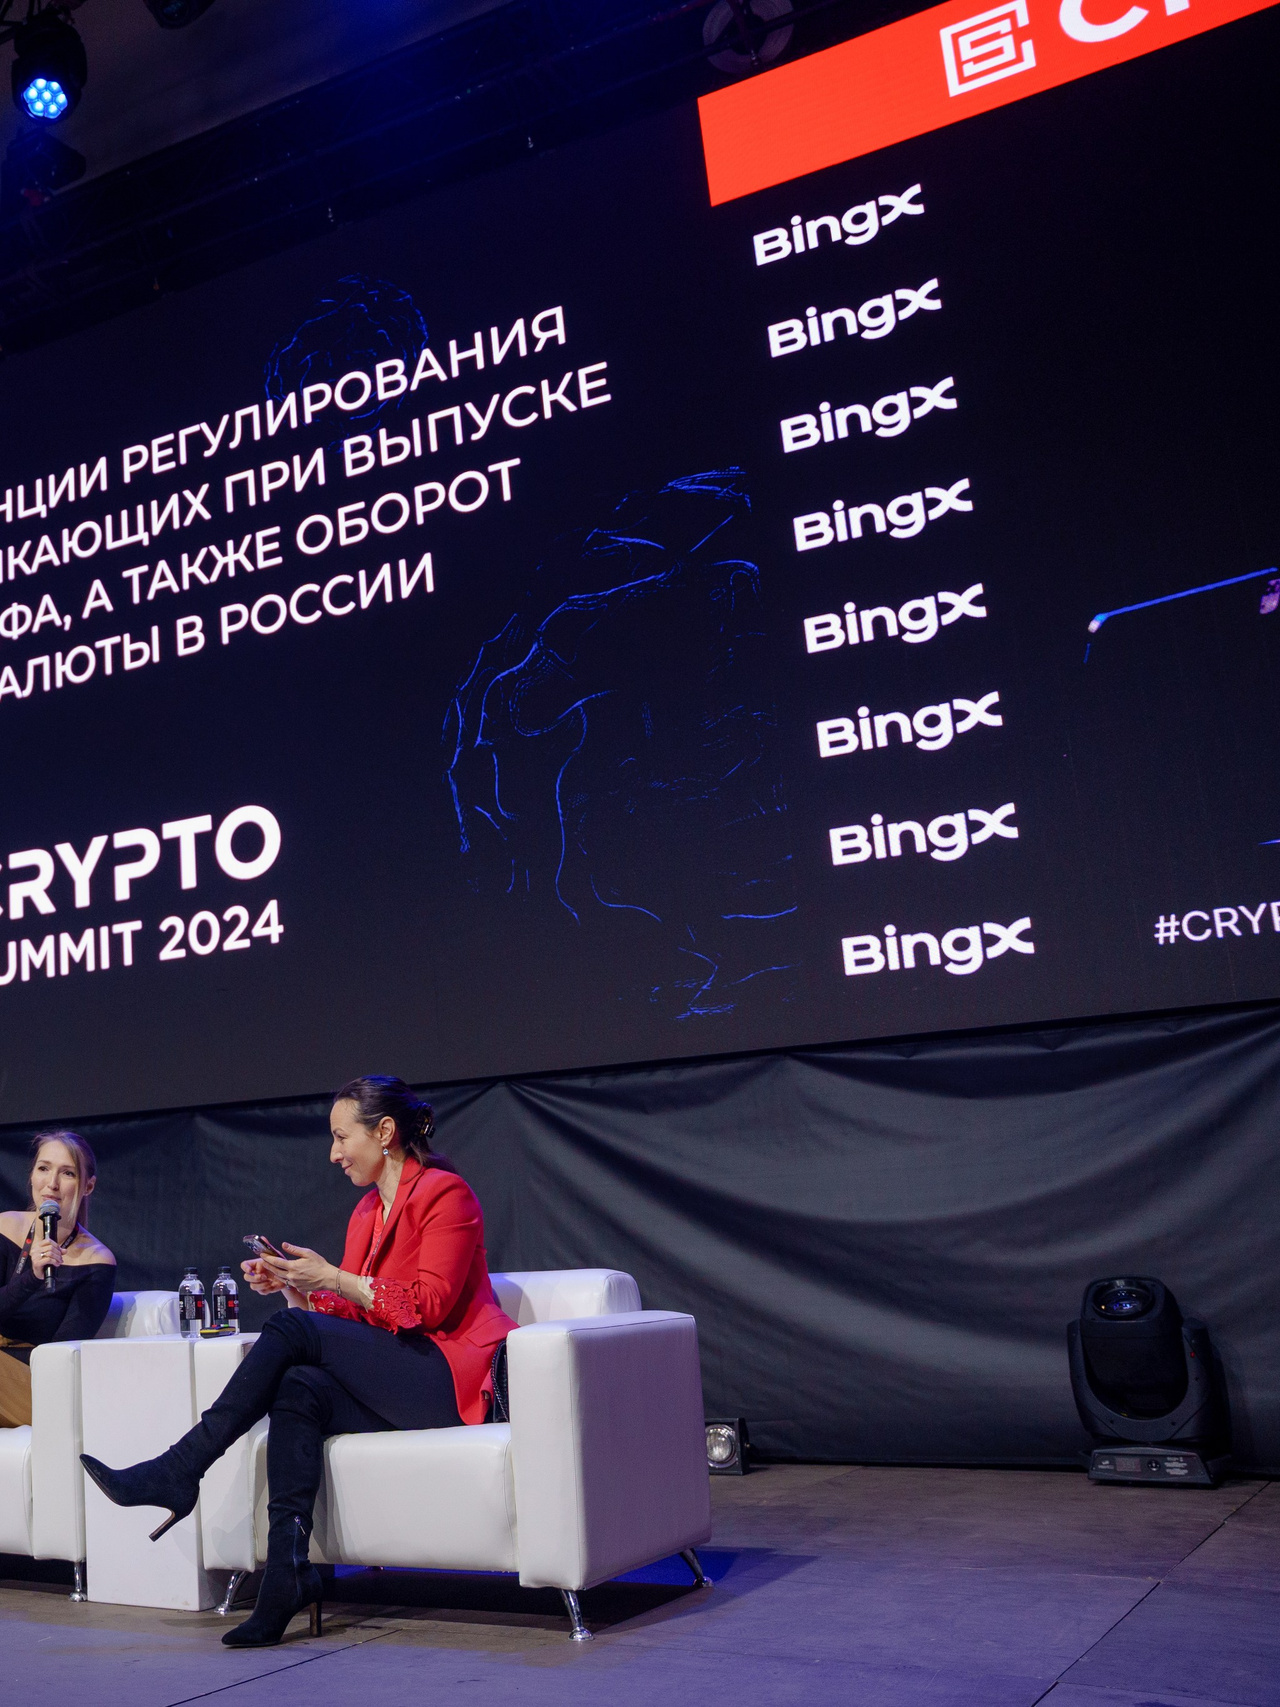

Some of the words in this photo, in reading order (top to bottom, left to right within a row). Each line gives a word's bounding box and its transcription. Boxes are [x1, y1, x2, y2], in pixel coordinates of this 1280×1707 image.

[122, 305, 566, 484] РЕГУЛИРОВАНИЯ
[225, 447, 326, 513] ПРИ
[343, 361, 612, 478] ВЫПУСКЕ
[81, 578, 114, 619] А
[121, 525, 283, 605] ТАКЖЕ
[296, 457, 521, 555] ОБОРОТ
[176, 615, 205, 657] В
[220, 552, 435, 645] РОССИИ
[159, 899, 284, 961] 2024
